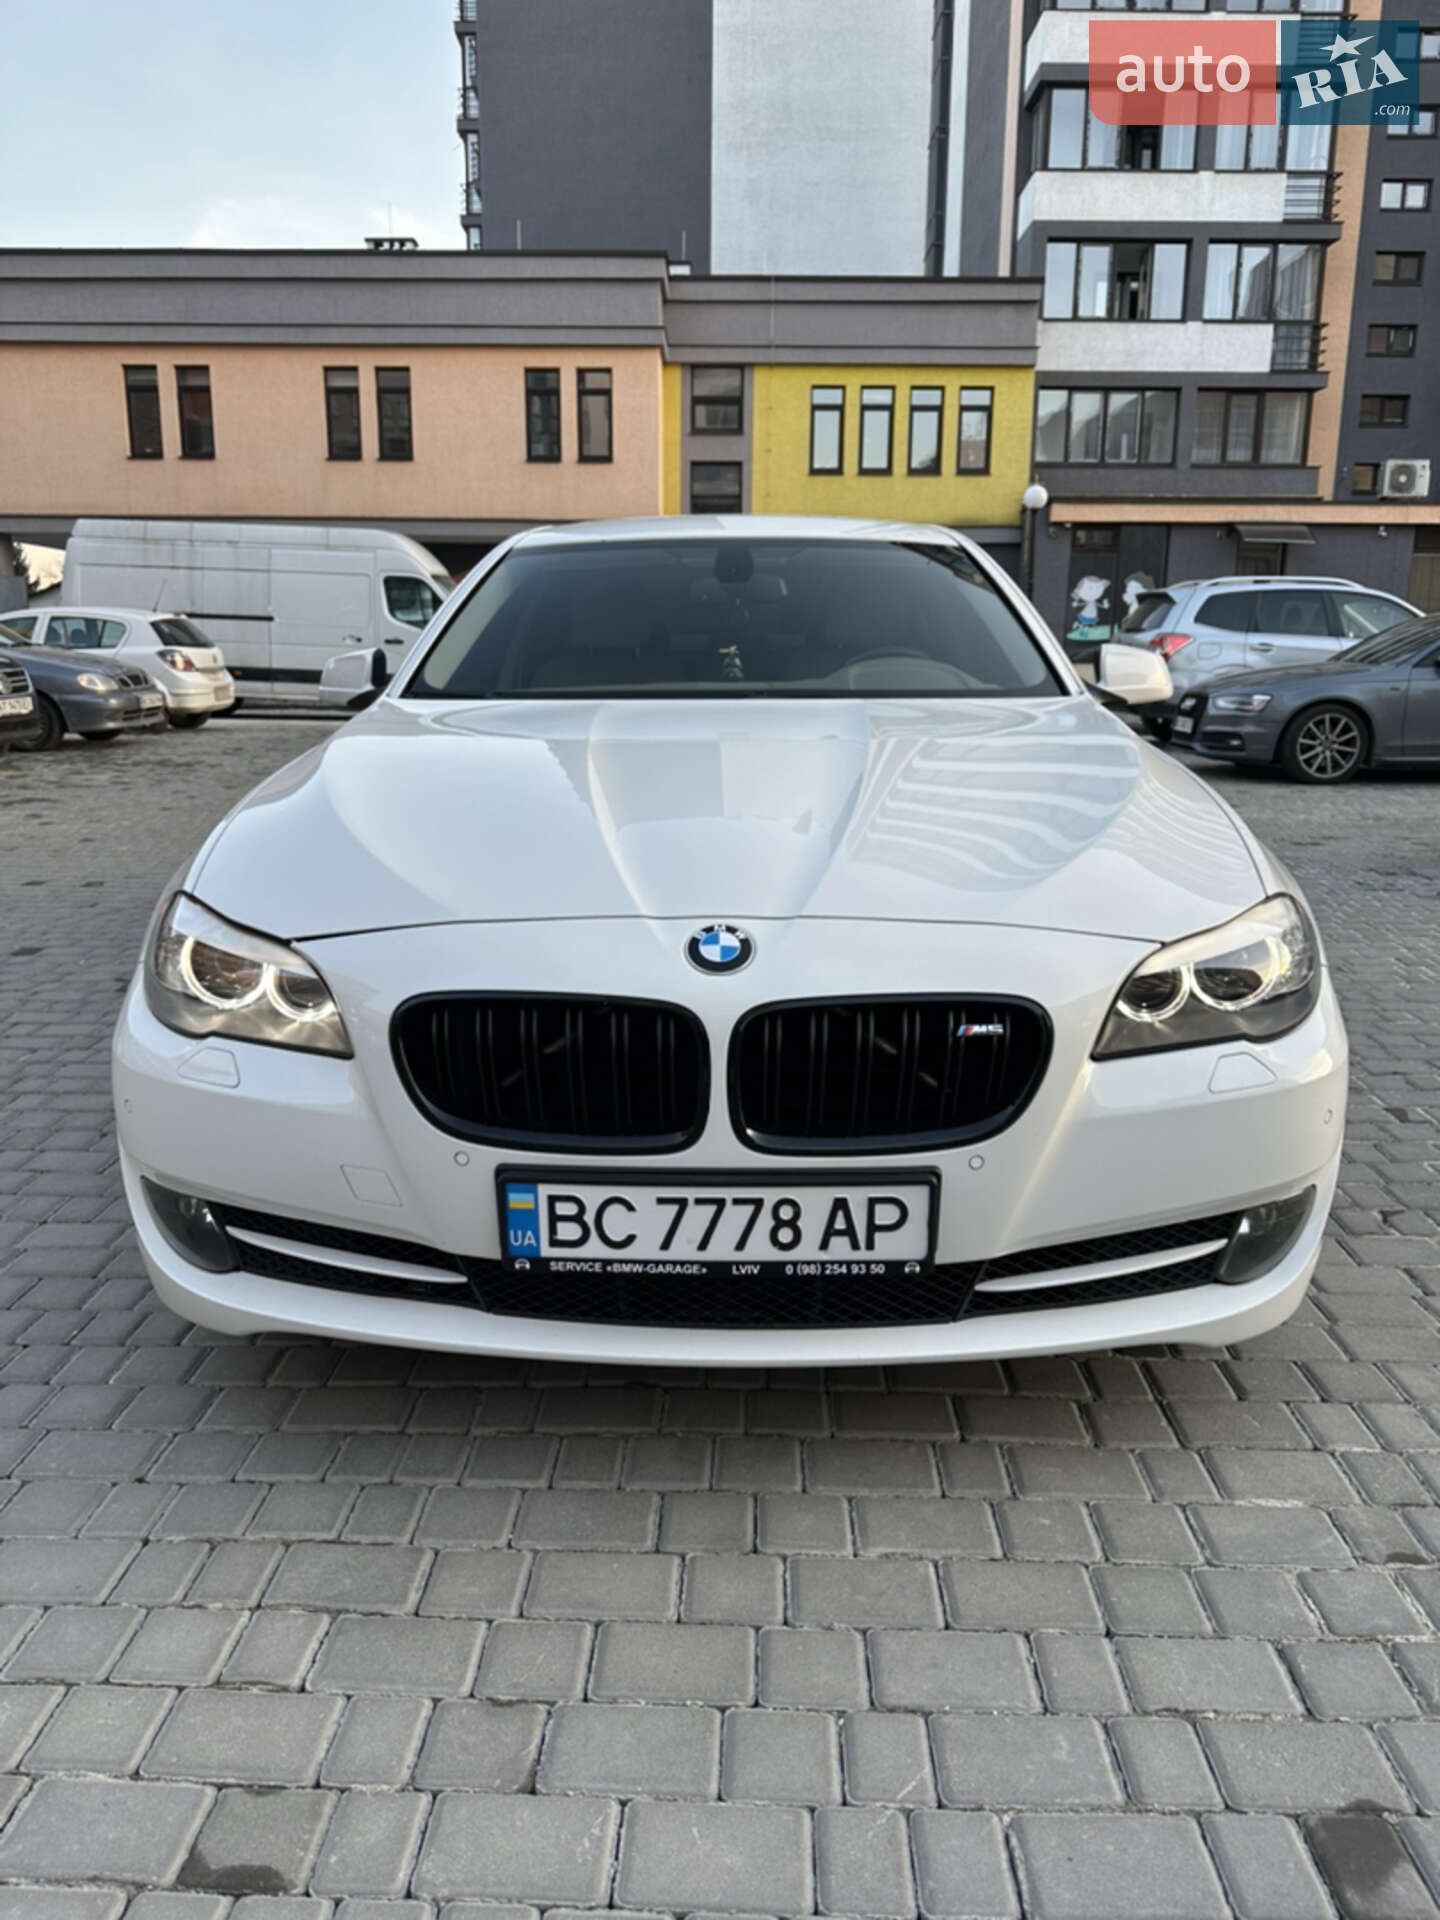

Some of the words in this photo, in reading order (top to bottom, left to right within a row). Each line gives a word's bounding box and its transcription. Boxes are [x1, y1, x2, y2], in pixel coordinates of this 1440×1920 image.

[547, 1194, 638, 1250] BC
[656, 1196, 802, 1251] 7778
[818, 1196, 909, 1251] AP
[509, 1229, 537, 1247] UA
[549, 1261, 603, 1272] SERVICE
[732, 1264, 760, 1275] LVIV
[785, 1264, 794, 1275] 0
[824, 1264, 847, 1275] 254
[851, 1264, 866, 1275] 93
[870, 1264, 885, 1275] 50
